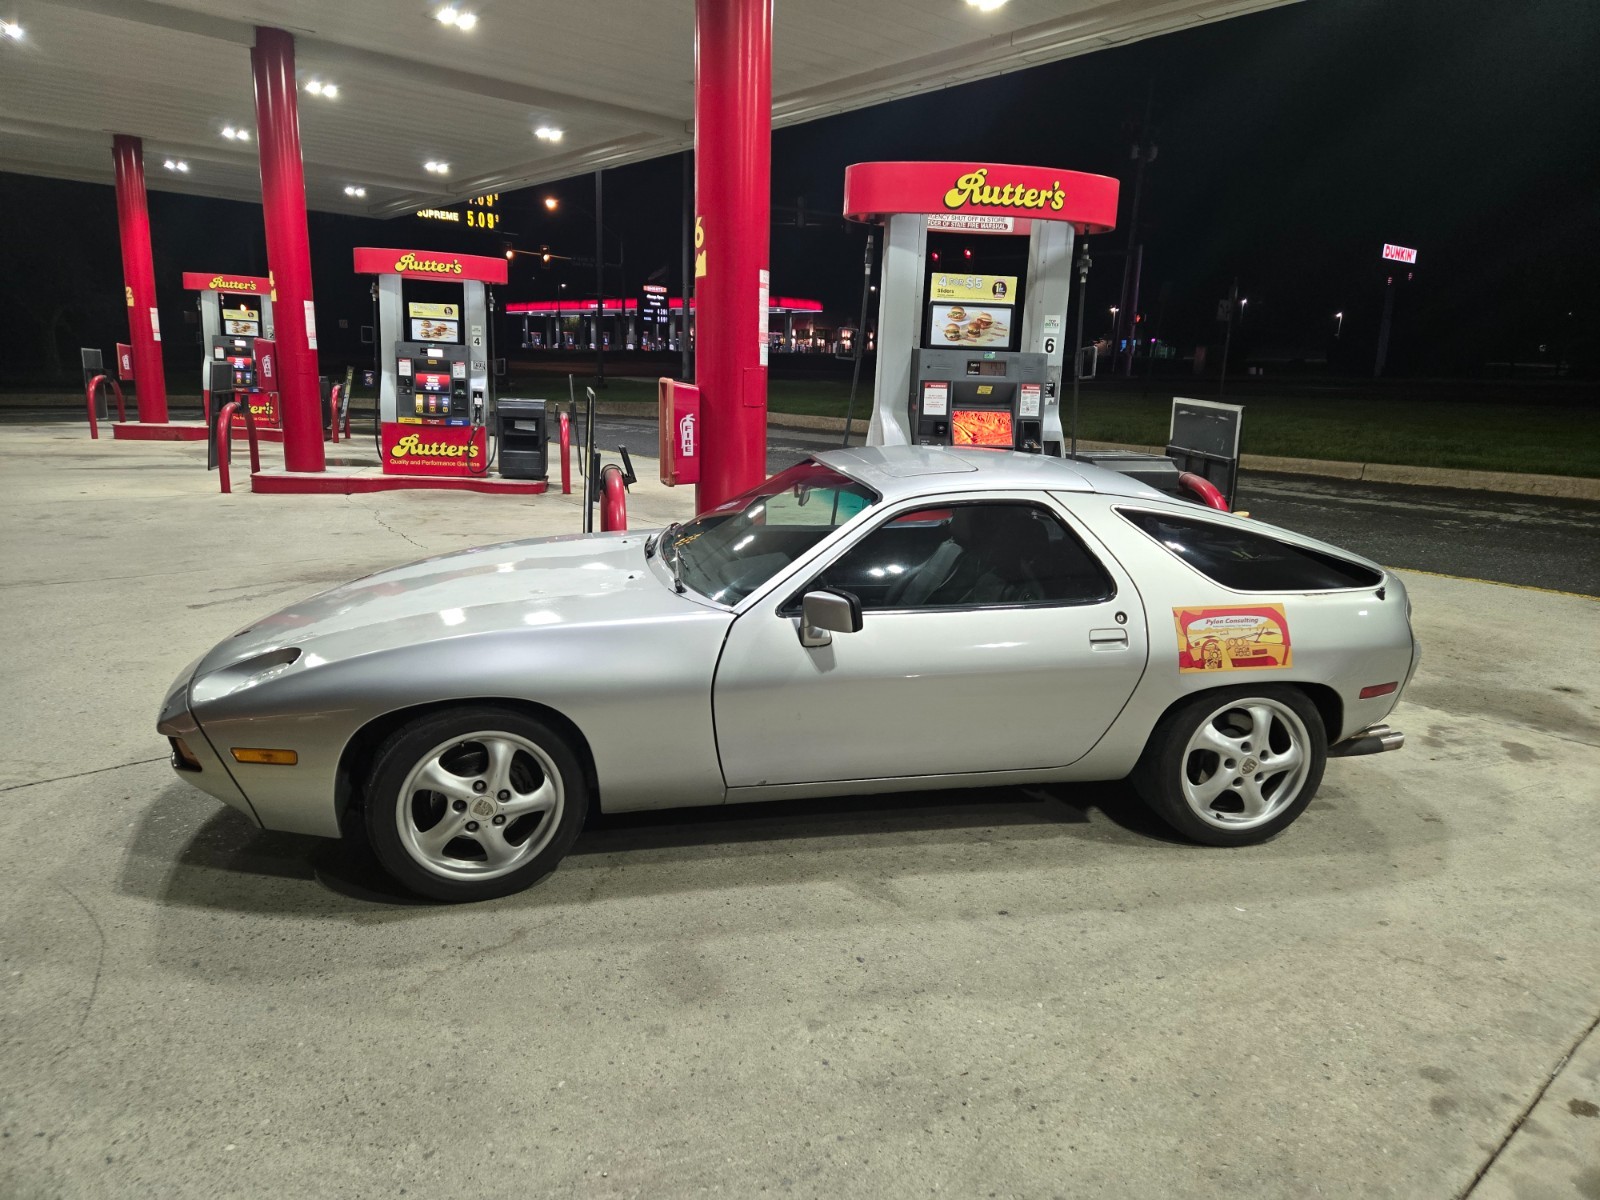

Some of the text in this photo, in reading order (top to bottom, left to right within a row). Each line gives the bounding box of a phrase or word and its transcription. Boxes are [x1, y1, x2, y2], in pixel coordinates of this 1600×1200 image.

[943, 168, 1066, 211] Rutter's
[417, 208, 460, 222] SUPREME
[695, 216, 704, 248] 6
[394, 253, 463, 274] Rutter's
[209, 275, 257, 291] Rutter's
[938, 276, 947, 287] 4
[965, 276, 983, 290] $5
[125, 286, 133, 298] 2
[473, 337, 480, 345] 4
[1045, 337, 1055, 353] 6
[391, 433, 479, 458] Rutter's
[684, 425, 692, 453] FIRE
[390, 458, 409, 466] Quality
